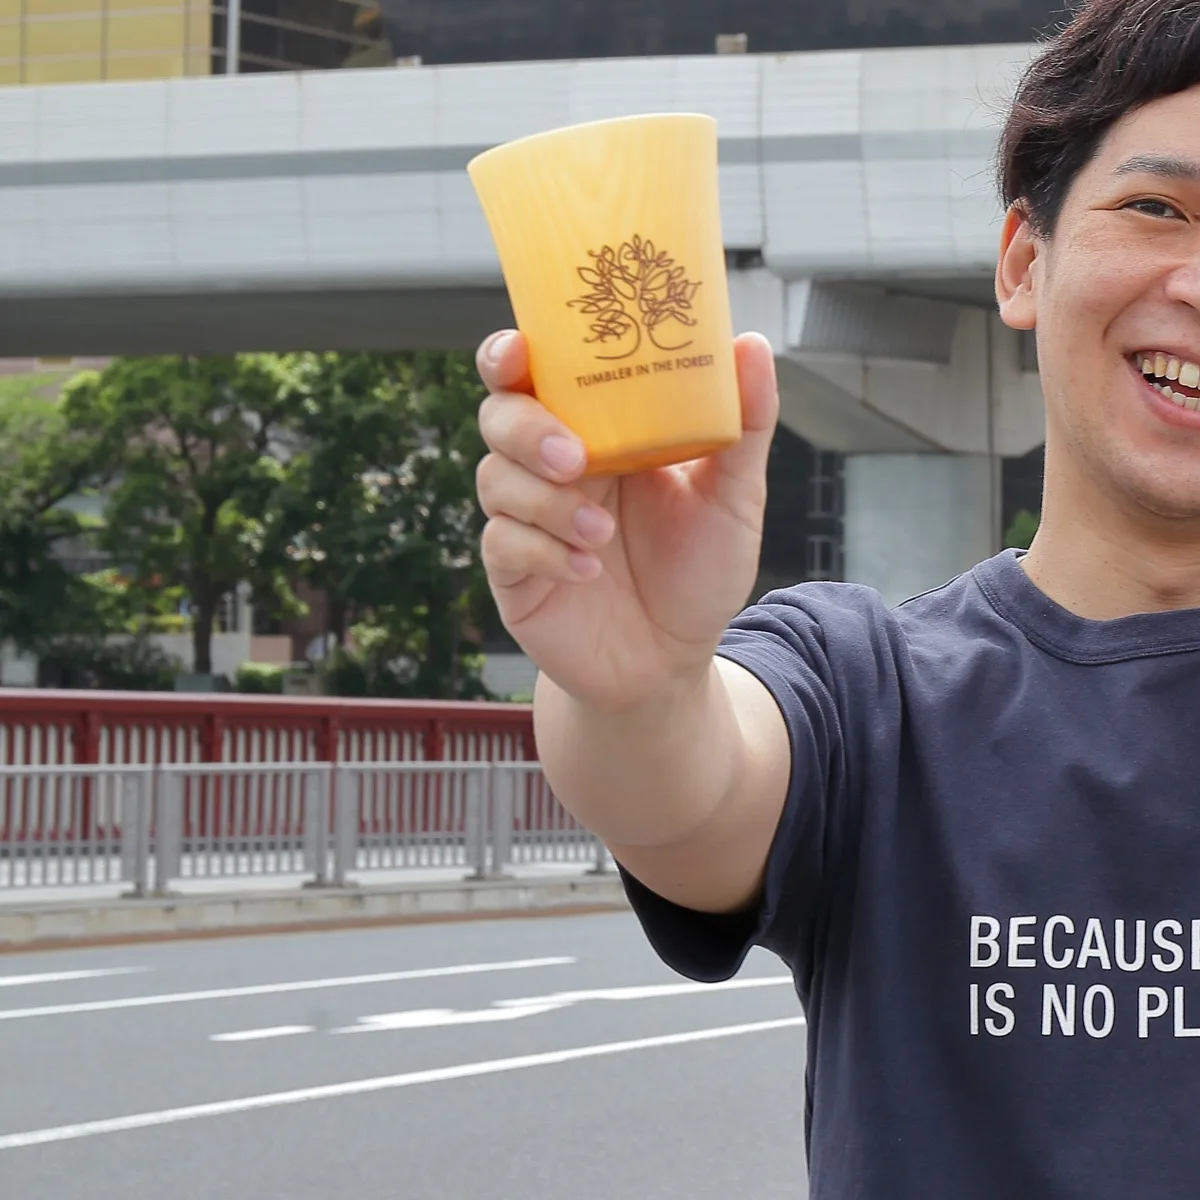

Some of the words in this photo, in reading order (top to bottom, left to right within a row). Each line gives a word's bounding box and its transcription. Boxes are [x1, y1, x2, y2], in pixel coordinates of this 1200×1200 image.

[575, 367, 634, 388] TUMBLER
[635, 363, 650, 376] IN
[651, 360, 674, 373] THE
[675, 354, 715, 370] FOREST
[969, 982, 1016, 1037] IS
[1040, 982, 1116, 1039] NO
